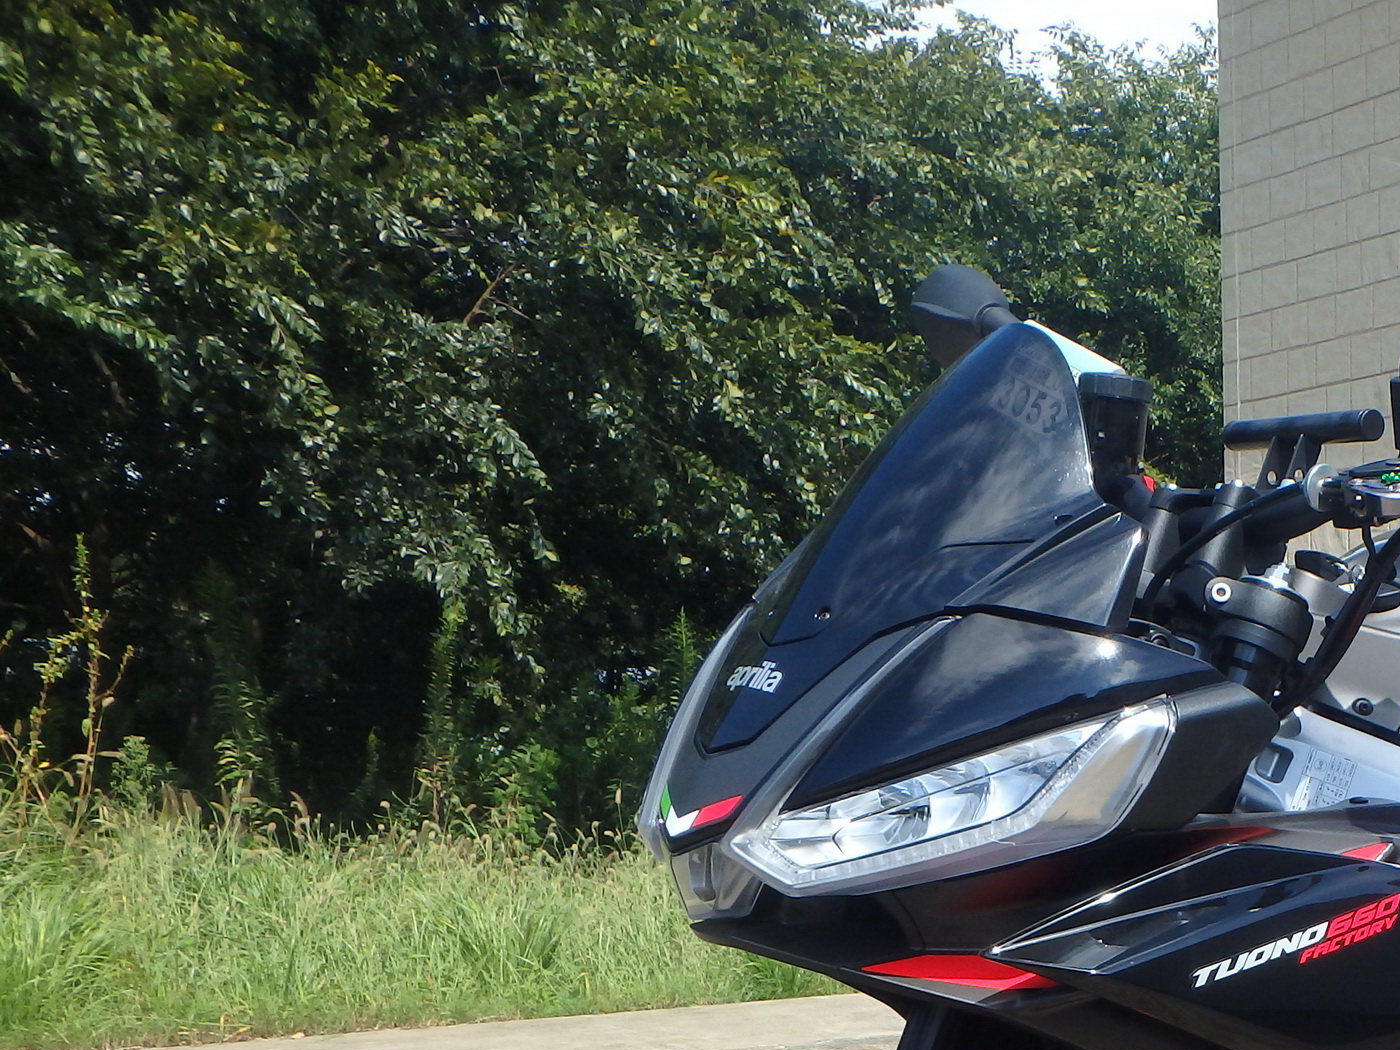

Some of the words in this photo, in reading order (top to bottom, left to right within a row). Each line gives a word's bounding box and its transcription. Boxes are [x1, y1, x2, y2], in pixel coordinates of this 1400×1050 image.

[726, 660, 783, 693] aprilia
[1192, 921, 1329, 988] TUONO
[1299, 914, 1400, 964] FACTORY
